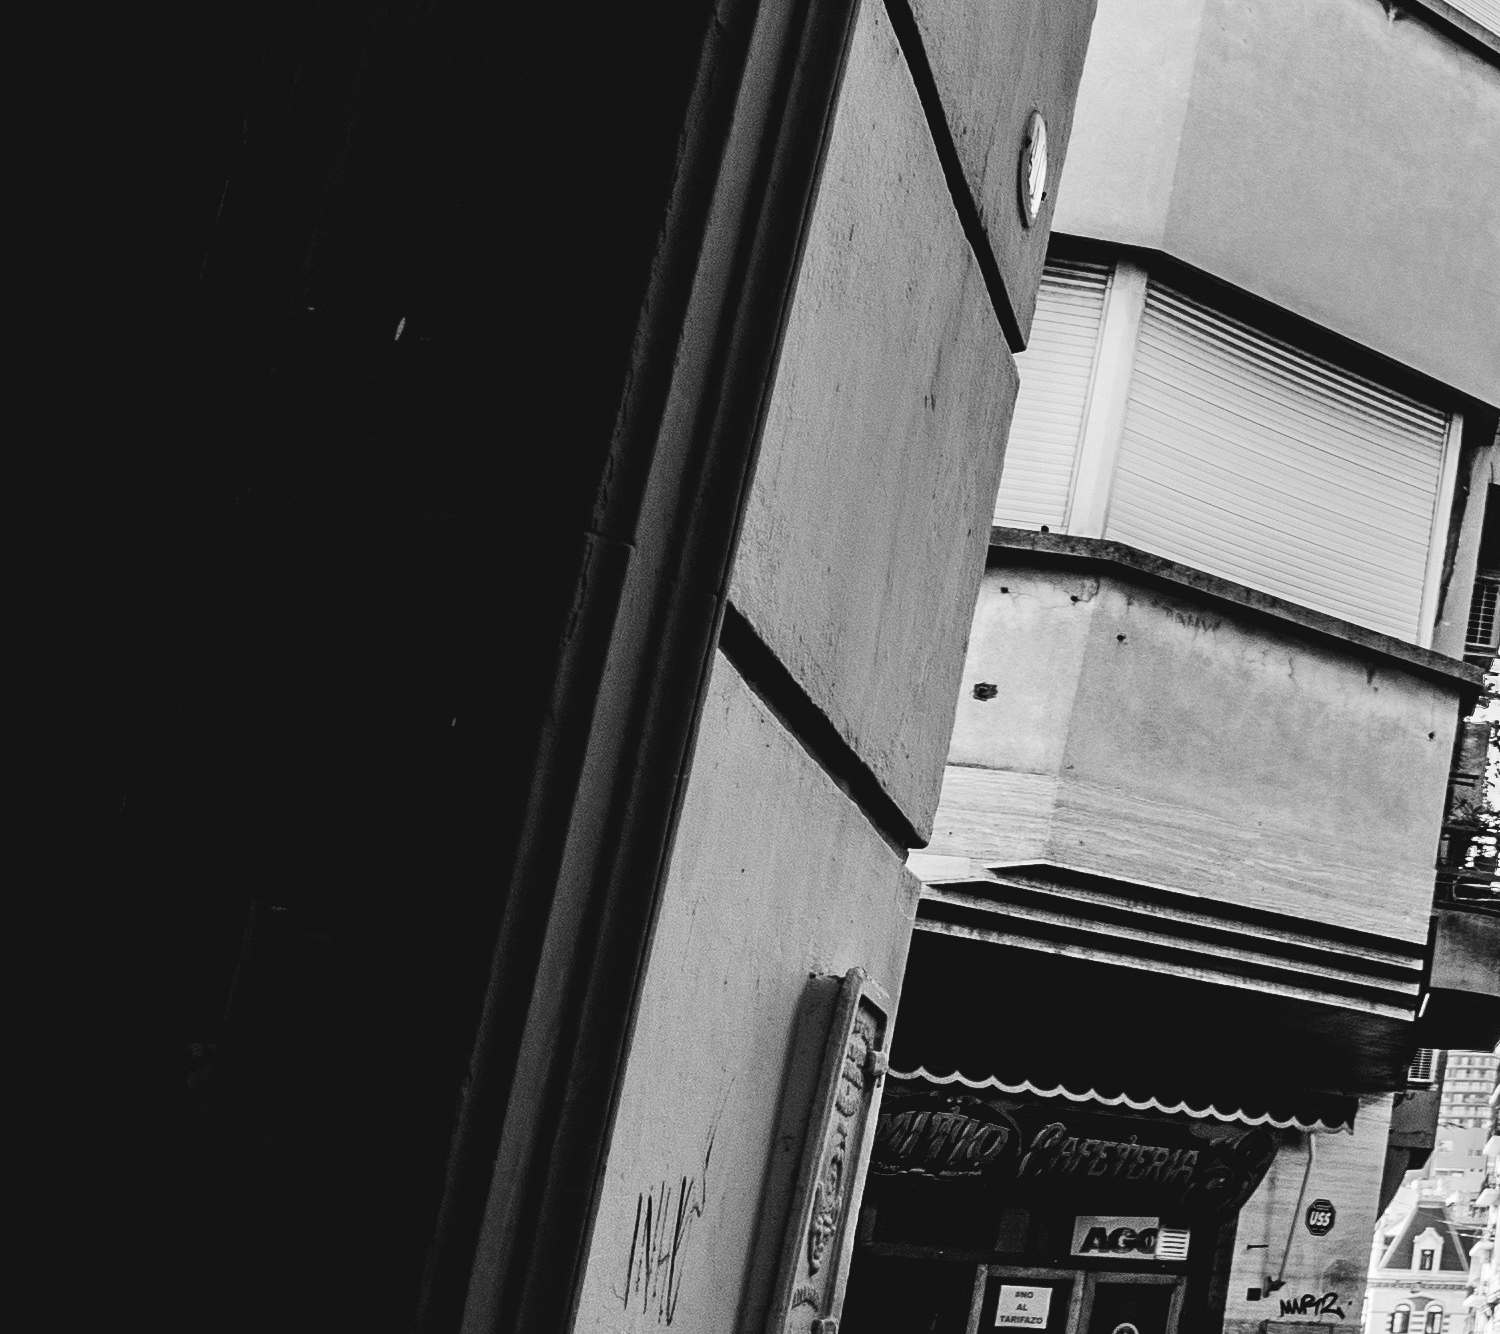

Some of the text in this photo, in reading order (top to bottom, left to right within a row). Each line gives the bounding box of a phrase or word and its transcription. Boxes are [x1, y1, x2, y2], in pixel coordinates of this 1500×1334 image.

[1015, 1291, 1034, 1299] #NO
[1016, 1303, 1028, 1311] AL
[1000, 1315, 1043, 1324] TARIFAZO
